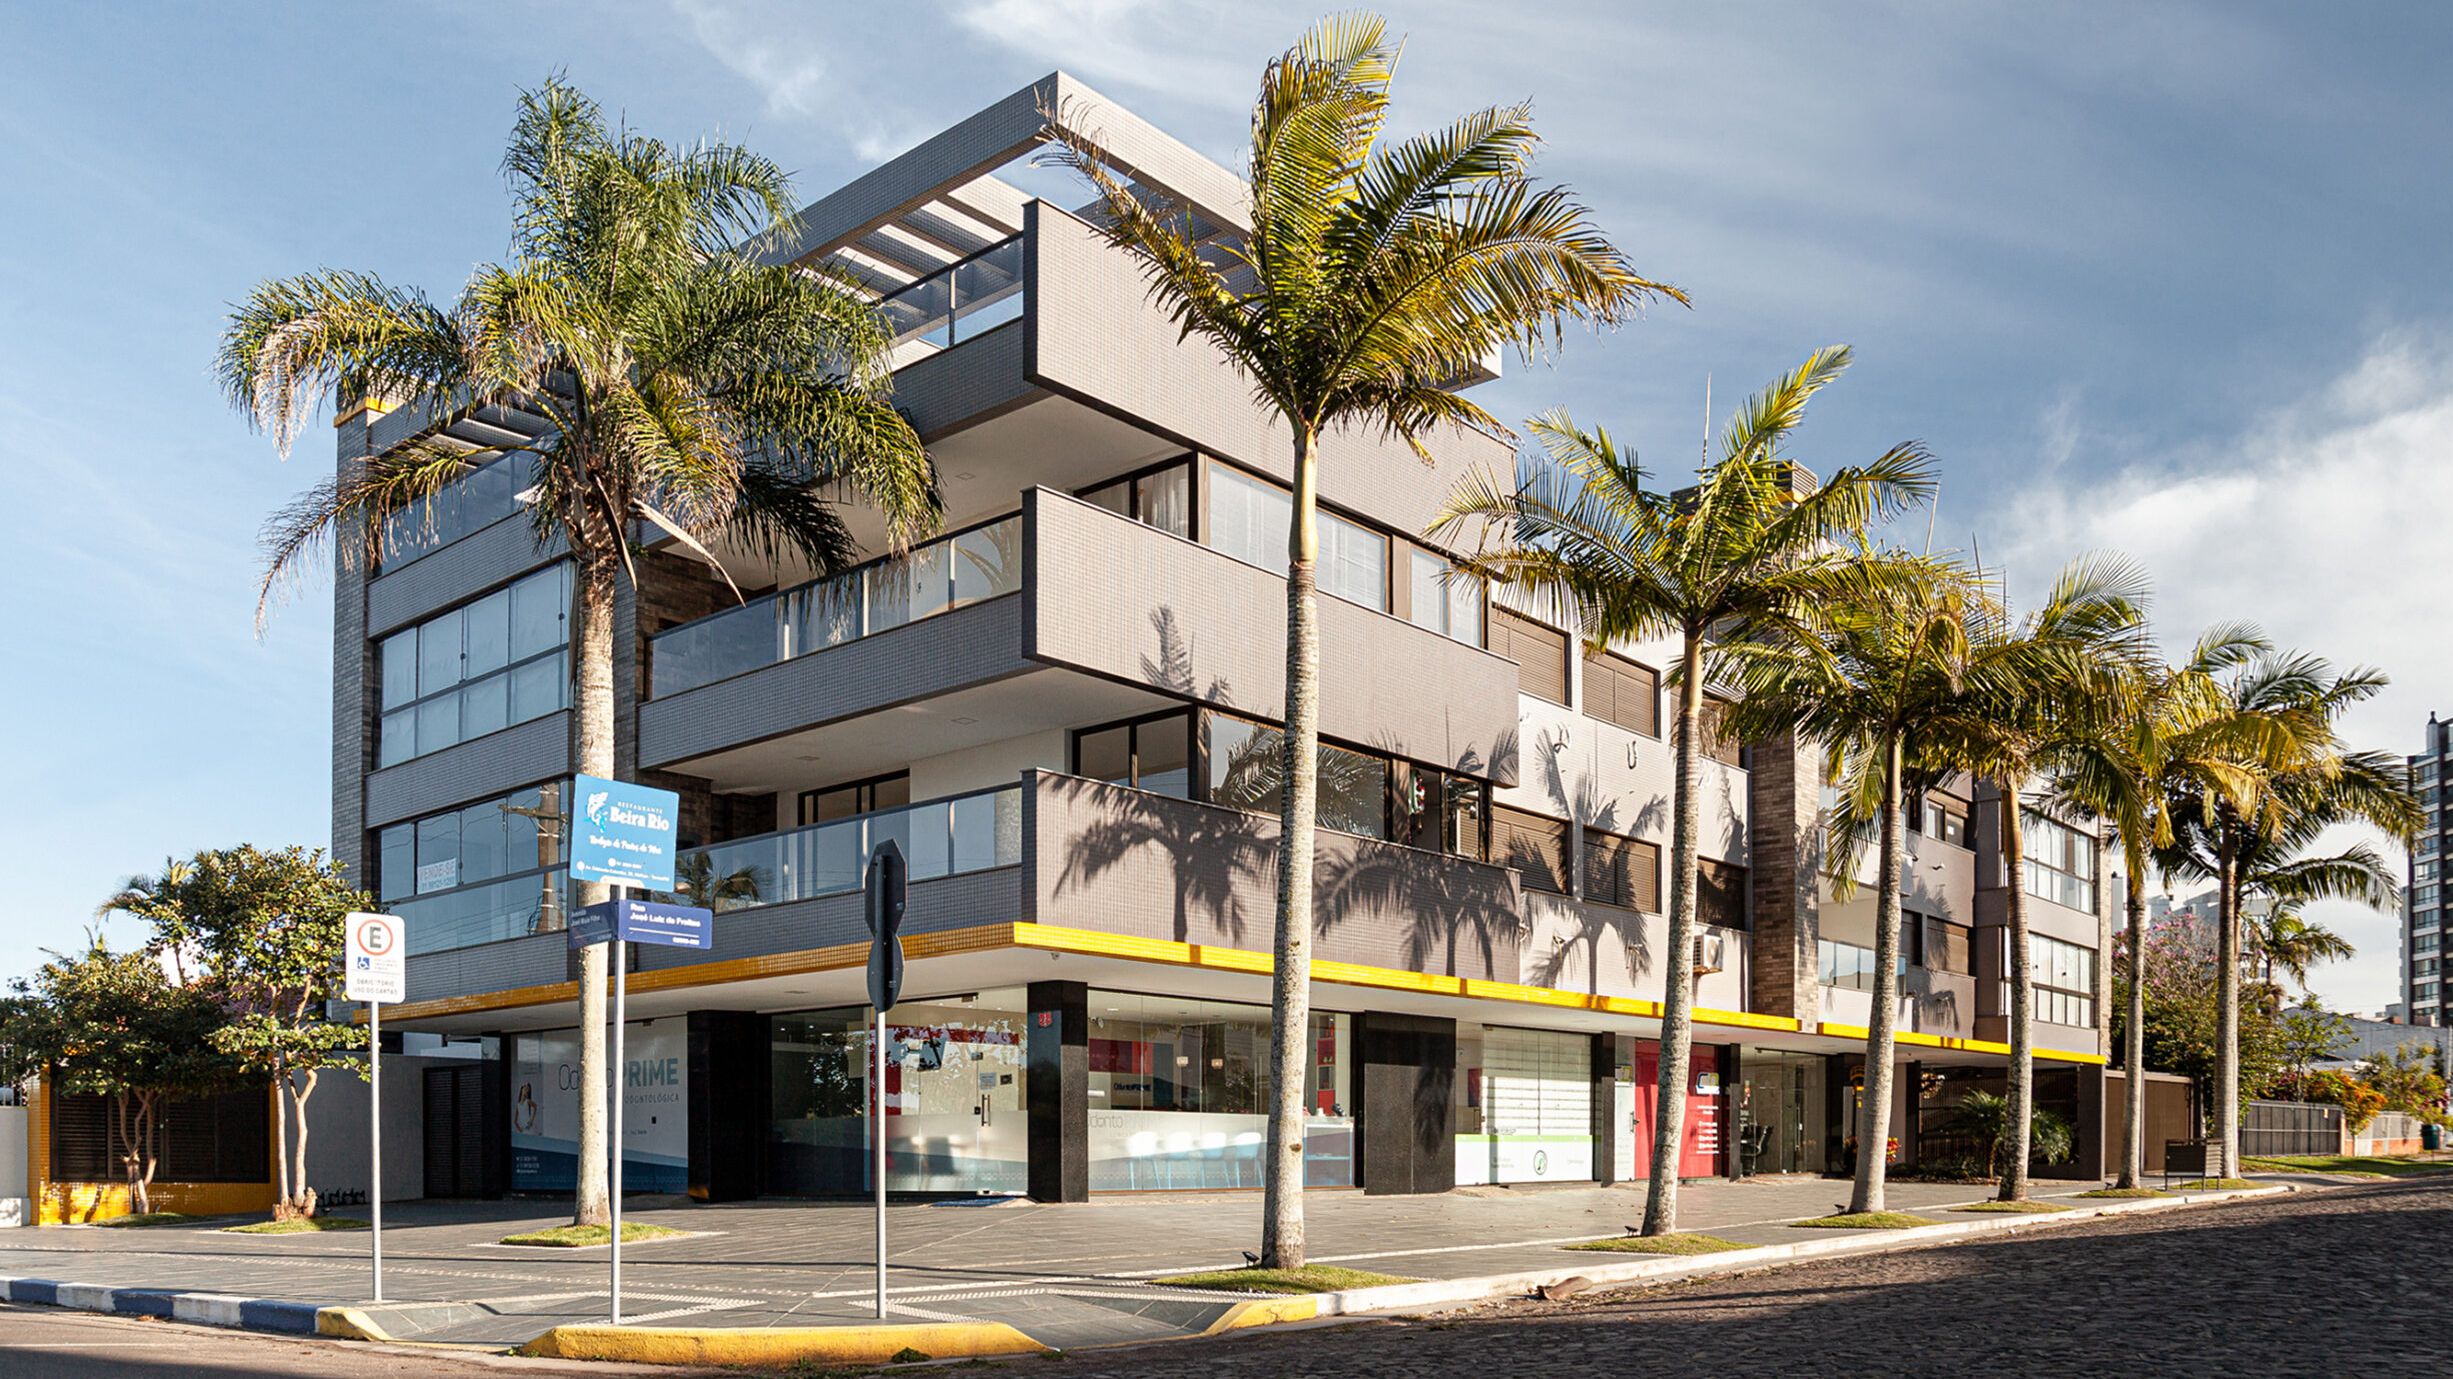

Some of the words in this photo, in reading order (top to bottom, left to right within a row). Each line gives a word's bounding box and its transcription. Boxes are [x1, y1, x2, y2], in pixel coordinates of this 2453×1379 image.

[617, 801, 664, 815] RESTAURANTE
[610, 806, 646, 828] Beira
[647, 812, 670, 832] Rio
[630, 903, 646, 913] Rua
[630, 912, 648, 923] José
[649, 914, 665, 924] Luiz
[666, 916, 676, 925] de
[676, 917, 702, 928] Freitas
[369, 926, 382, 948] E
